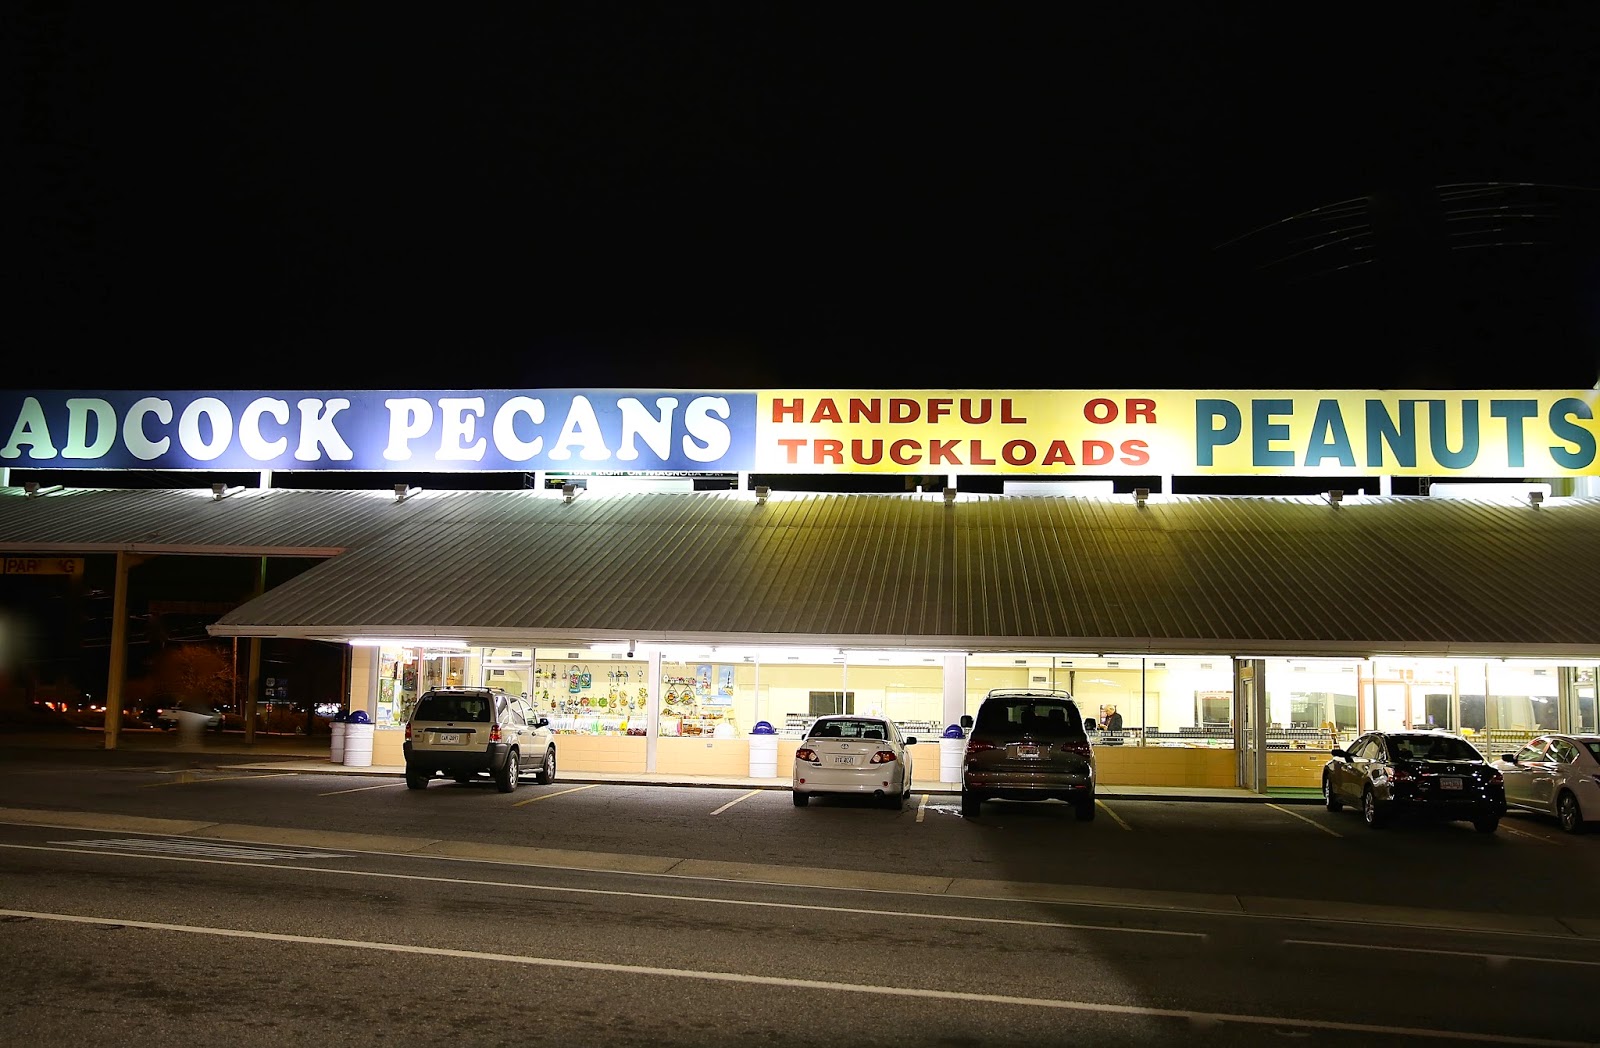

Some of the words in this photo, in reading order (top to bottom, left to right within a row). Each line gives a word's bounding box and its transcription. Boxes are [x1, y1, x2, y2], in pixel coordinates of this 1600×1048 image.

[0, 396, 354, 462] ADCOCK
[383, 394, 732, 463] PECANS
[772, 397, 1027, 425] HANDFUL
[1083, 397, 1158, 425] OR
[1195, 397, 1598, 470] PEANUTS
[777, 438, 1151, 467] TRUCKLOADS
